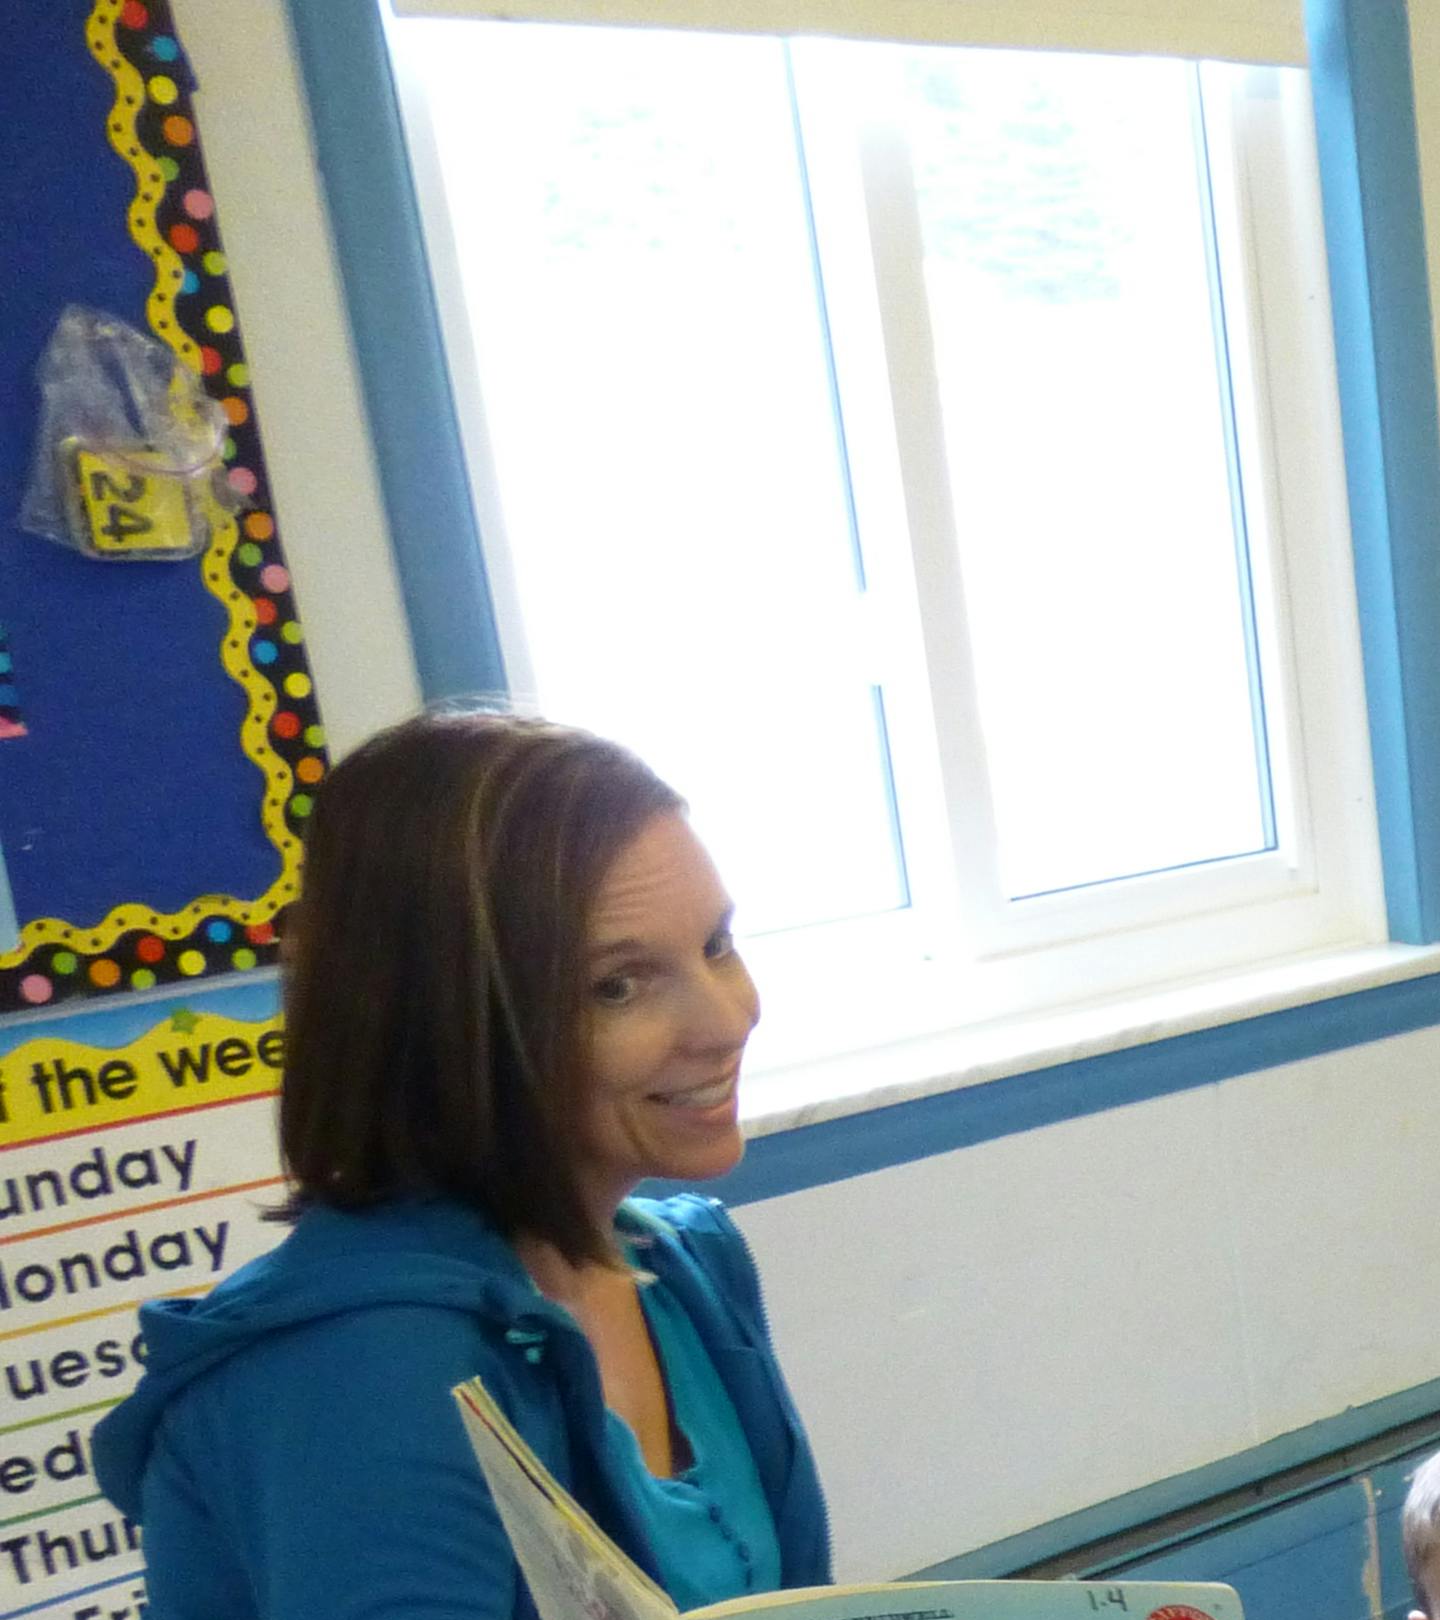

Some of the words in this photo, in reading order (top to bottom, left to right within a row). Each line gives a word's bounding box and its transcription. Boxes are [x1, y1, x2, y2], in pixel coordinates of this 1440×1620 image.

[89, 471, 153, 542] 24
[31, 1058, 138, 1123] the
[157, 1029, 287, 1087] wee
[0, 1139, 196, 1211] unday
[0, 1221, 229, 1310] onday
[5, 1333, 149, 1400] ues
[0, 1430, 88, 1493] ed
[1, 1517, 141, 1584] Thur
